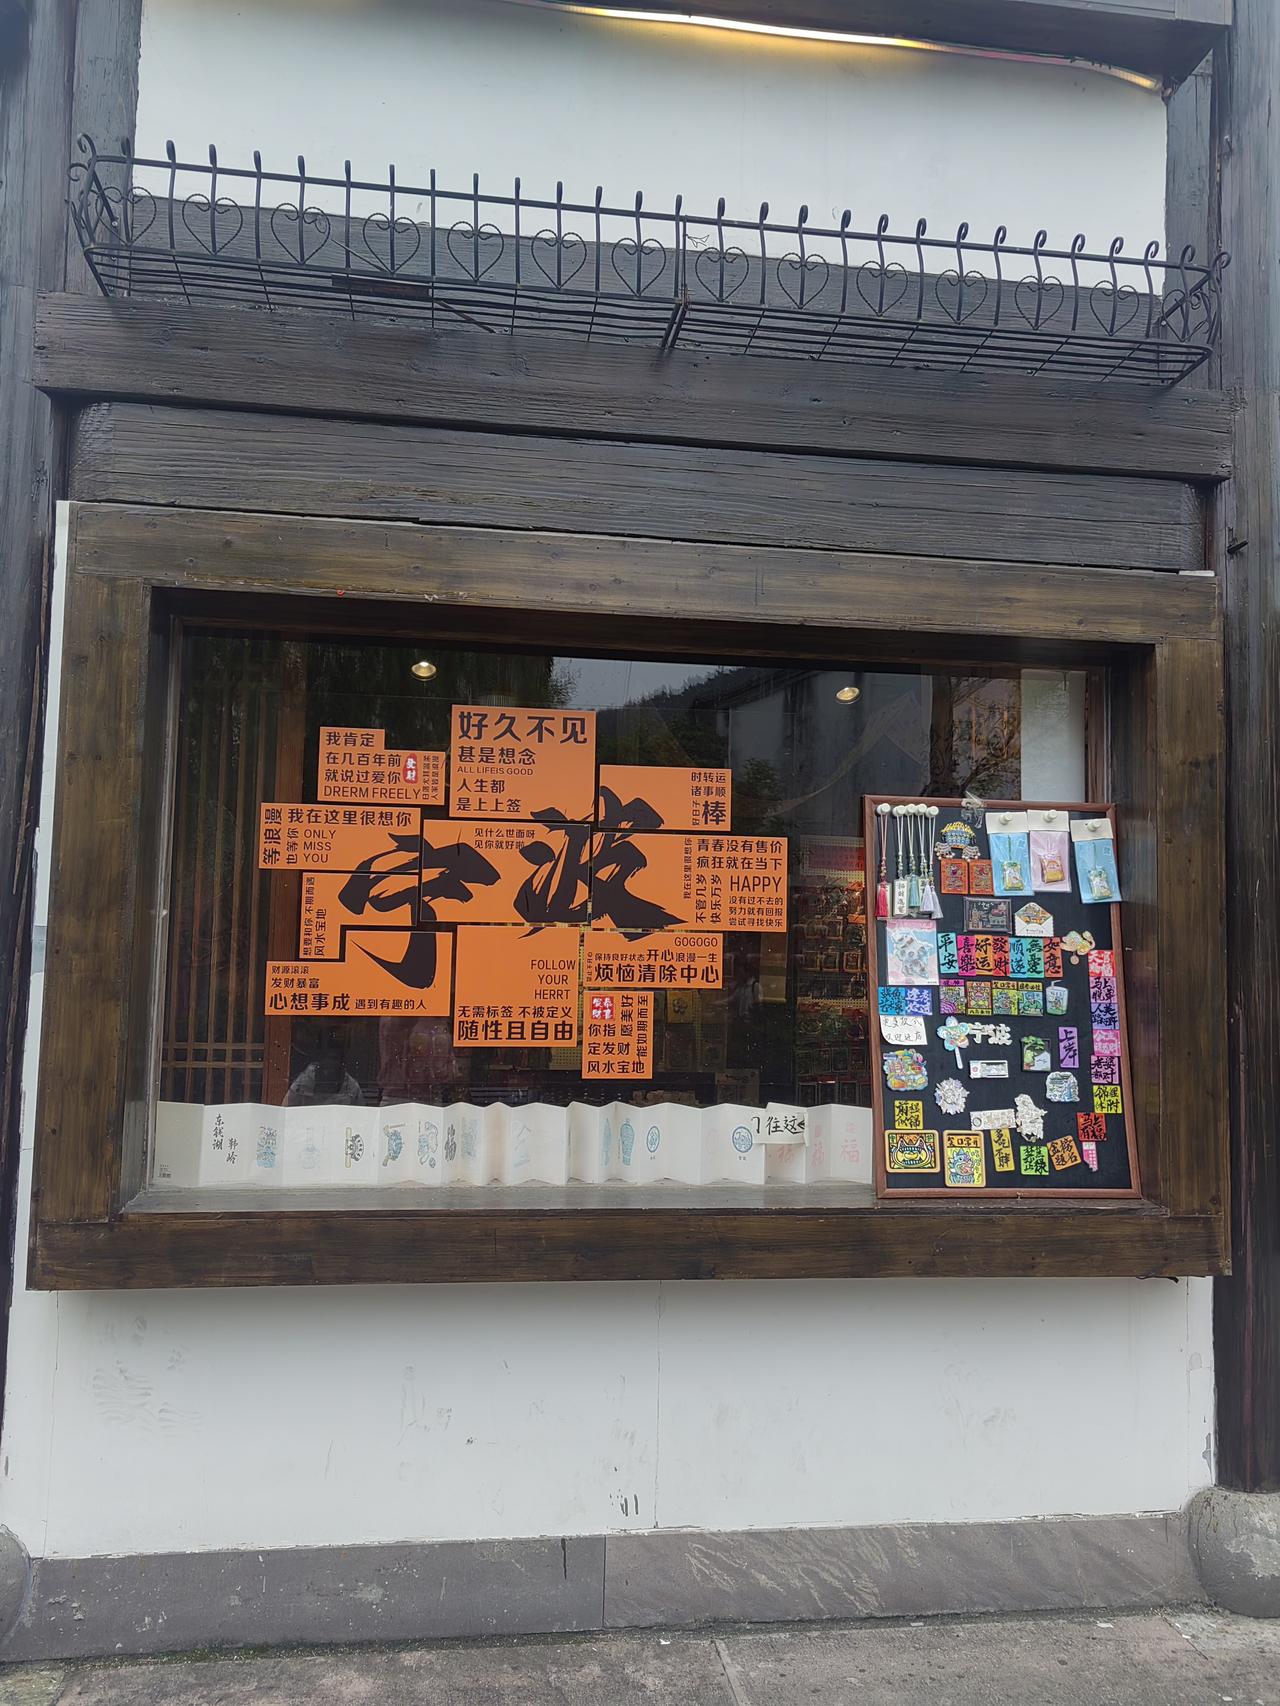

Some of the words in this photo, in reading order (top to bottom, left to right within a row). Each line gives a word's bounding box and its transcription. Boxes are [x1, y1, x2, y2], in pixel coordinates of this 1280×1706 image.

[458, 711, 588, 744] 好久不见
[326, 731, 375, 747] 我肯定
[326, 751, 401, 768] 在几百年前
[458, 745, 536, 765] 甚是想念
[325, 768, 401, 785] 就说过爱你
[507, 767, 533, 775] GOOD
[691, 772, 726, 783] 时转运
[324, 786, 369, 798] DRERM
[372, 787, 421, 799] FREELY
[457, 778, 506, 793] 人生都
[691, 785, 726, 797] 诸事顺
[456, 797, 522, 814] 是上上签
[288, 809, 412, 827] 我在这里很想你
[702, 801, 726, 826] 棒
[263, 808, 282, 864] 等浪漫
[304, 829, 336, 839] ONLY
[474, 829, 535, 839] 见什么世面呀
[286, 827, 299, 864] 也等你
[304, 841, 332, 851] MISS
[474, 840, 525, 850] 见你就好啦
[697, 838, 783, 855] 青春没有售价
[304, 853, 328, 864] YOU
[697, 855, 783, 871] 疯狂就在当下
[730, 877, 782, 892] HAPPY
[695, 874, 707, 923] 不管几岁
[710, 874, 722, 923] 快乐万岁
[729, 896, 783, 906] 没有过不去的
[729, 907, 783, 916] 努力就有回报
[729, 917, 783, 928] 尝试寻找快乐
[314, 908, 326, 956] 风水宝地
[674, 937, 718, 947] GOGOGO
[938, 933, 957, 970] 平安
[271, 966, 310, 975] 财源滚滚
[531, 960, 576, 970] FOLLOW
[538, 975, 569, 985] YOUR
[594, 963, 720, 984] 烦恼清除中心
[271, 977, 320, 989] 发财暴富
[270, 993, 350, 1011] 心想事成
[534, 989, 571, 1000] HERRT
[355, 998, 427, 1010] 遇到有趣的人
[458, 1006, 514, 1018] 无需标签
[518, 1006, 573, 1019] 不被定义
[621, 995, 634, 1037] 愿美好
[458, 1020, 574, 1042] 随性且自由
[588, 1024, 616, 1038] 你指
[636, 995, 649, 1057] 能如期而至
[588, 1042, 630, 1056] 定发财
[1059, 1029, 1078, 1067] 上岸
[587, 1061, 645, 1075] 风水宝地
